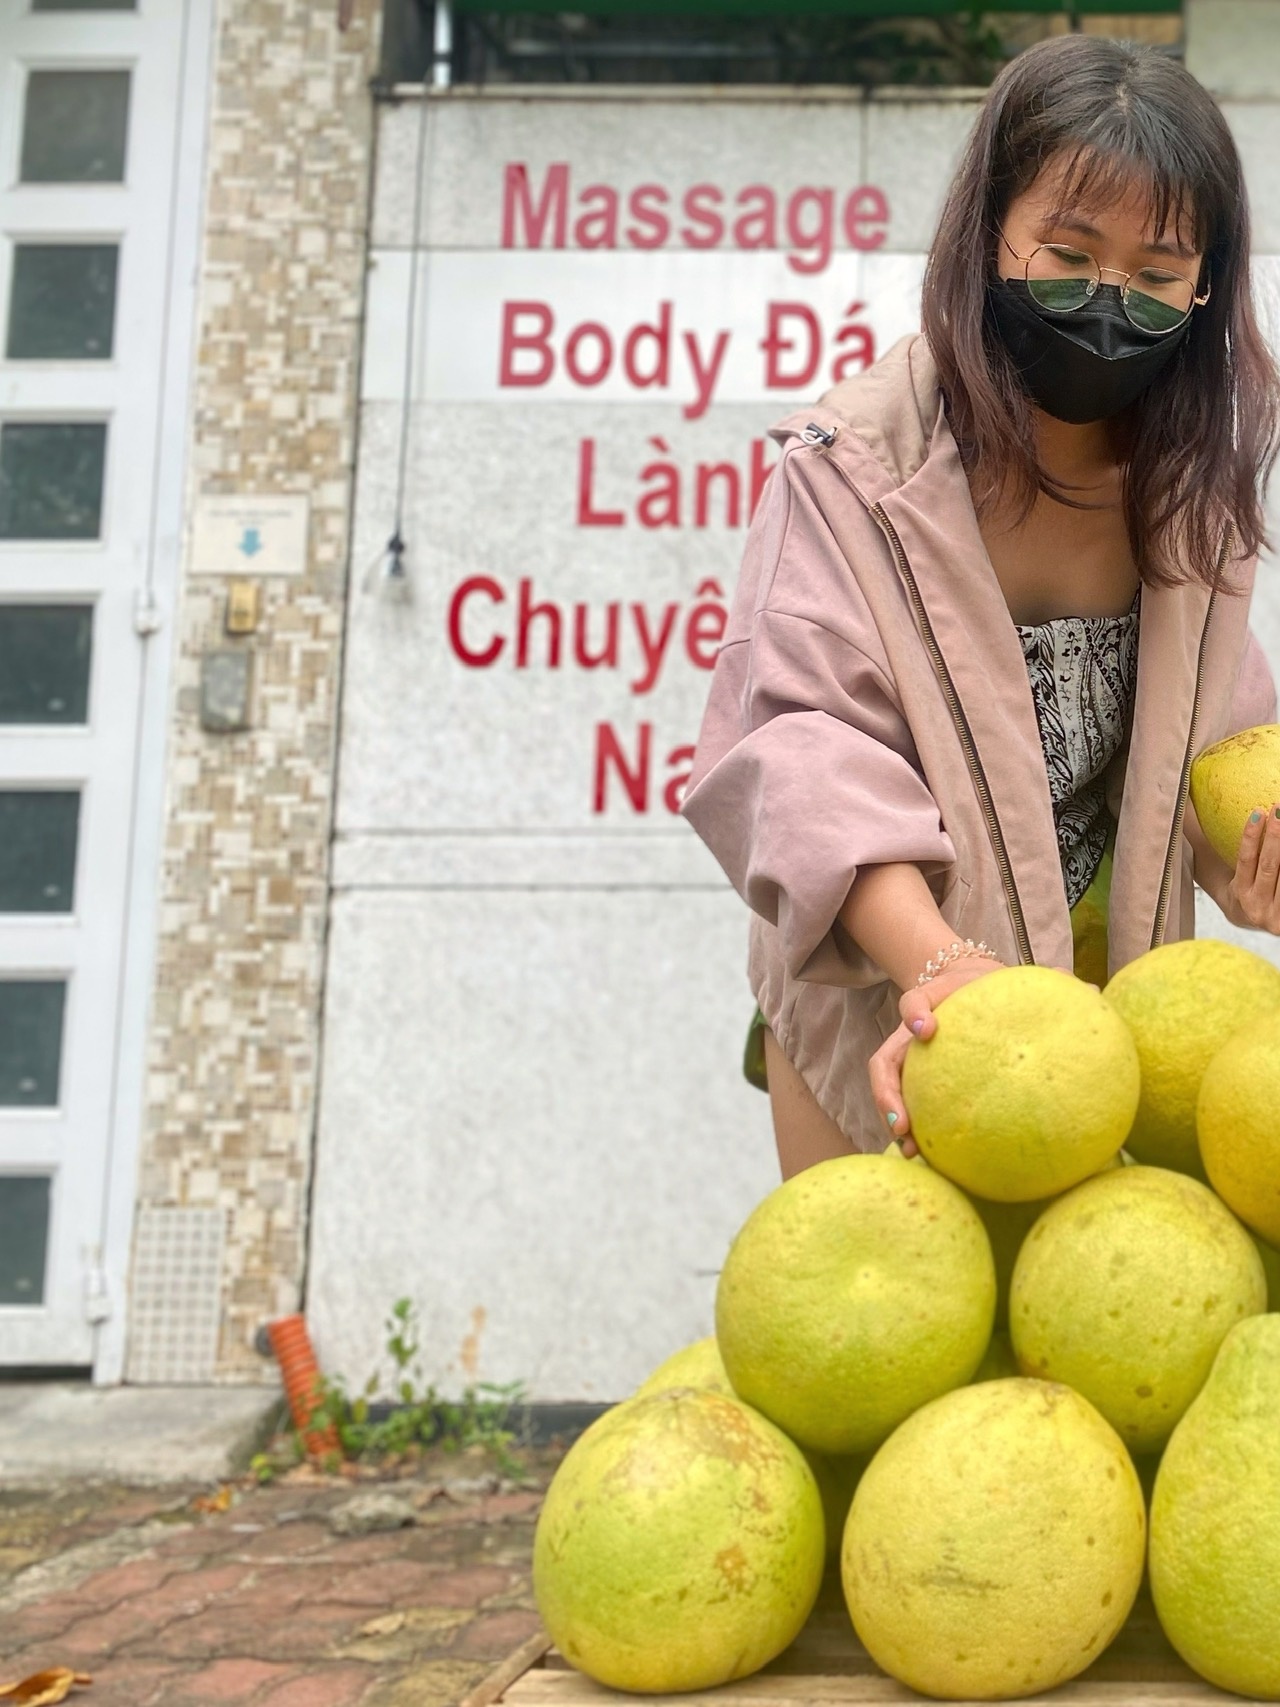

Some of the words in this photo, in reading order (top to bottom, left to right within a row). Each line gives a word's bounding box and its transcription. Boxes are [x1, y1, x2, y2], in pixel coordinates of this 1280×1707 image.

[500, 162, 892, 277] Massage
[498, 299, 732, 421] Body
[759, 299, 877, 389] Đá
